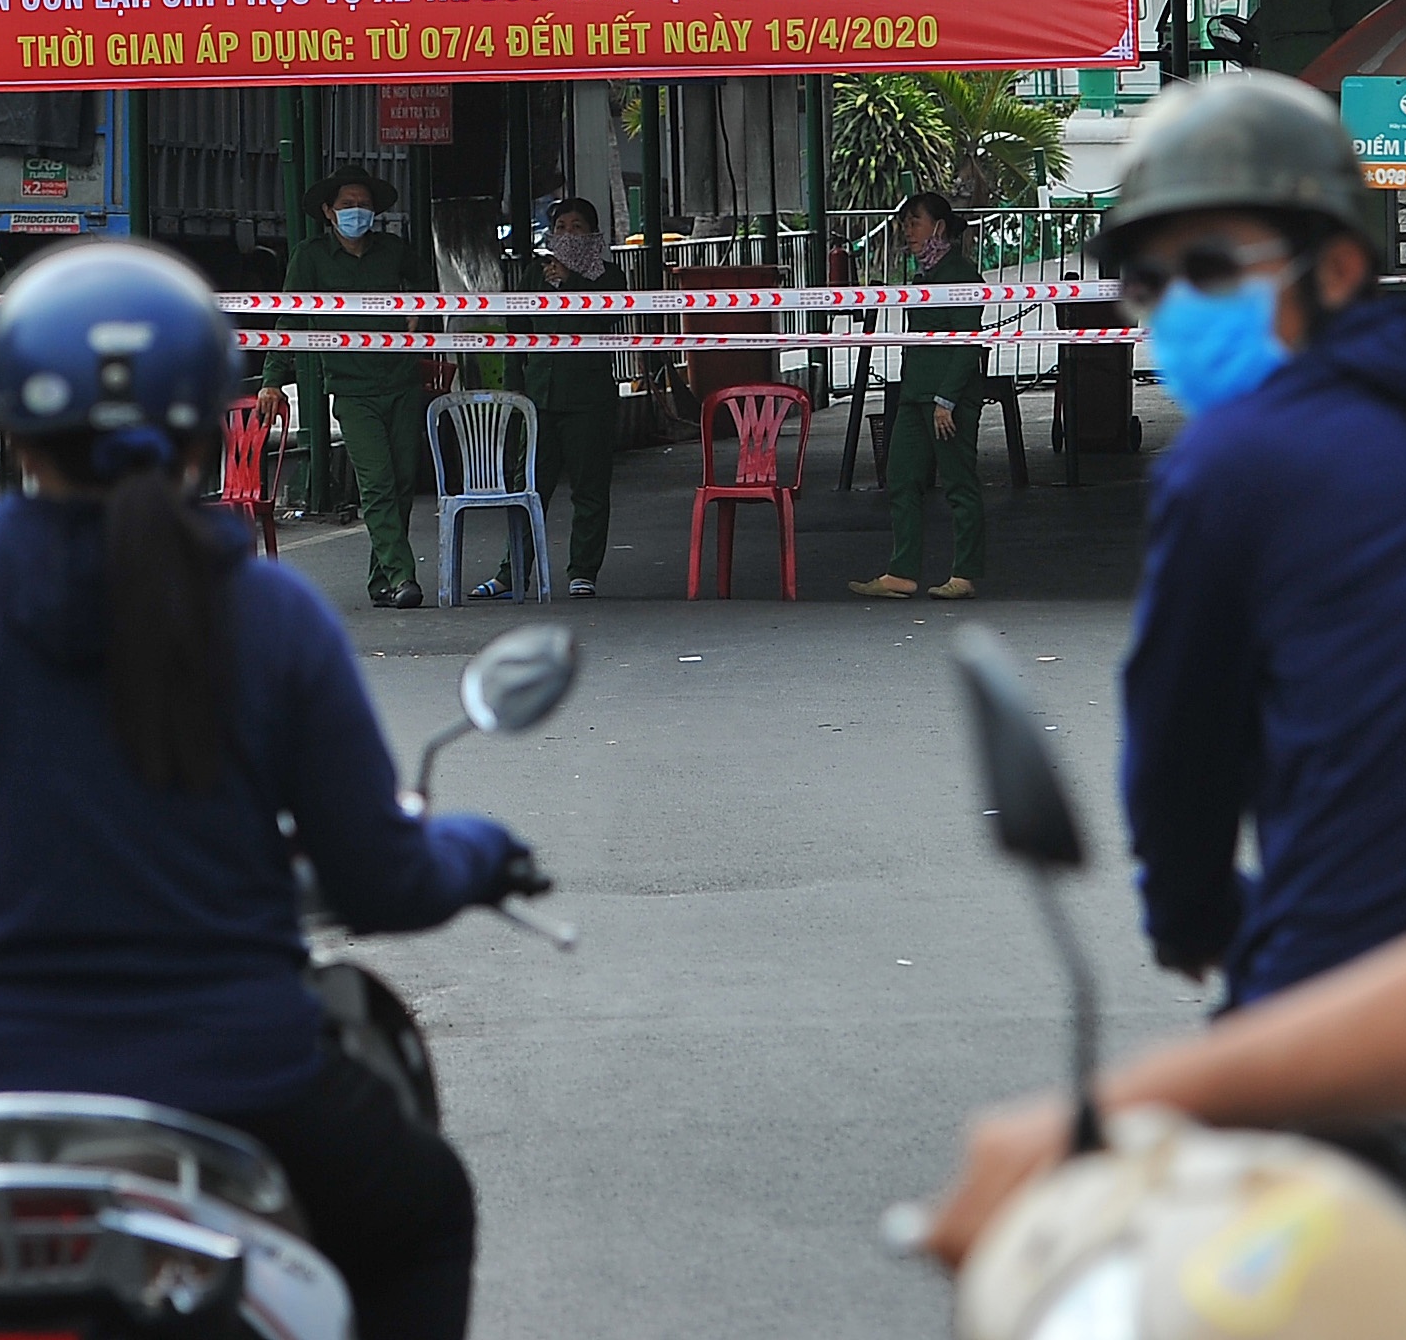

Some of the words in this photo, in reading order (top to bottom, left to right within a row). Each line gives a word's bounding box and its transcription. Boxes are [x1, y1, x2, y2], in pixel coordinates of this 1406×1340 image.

[18, 25, 94, 68] THỜI
[106, 30, 184, 67] GIAN
[195, 21, 240, 64] ÁP
[250, 27, 355, 69] DỤNG:
[366, 19, 411, 61] TỪ
[420, 23, 494, 60] 07/4
[506, 13, 574, 56] ĐẾN
[586, 12, 651, 56] HẾT
[662, 12, 753, 54] NGÀY
[763, 14, 938, 52] 15/4/2020
[1352, 134, 1400, 156] ĐIỂM
[26, 158, 63, 171] CRB
[13, 215, 77, 224] BRIDGESTONE
